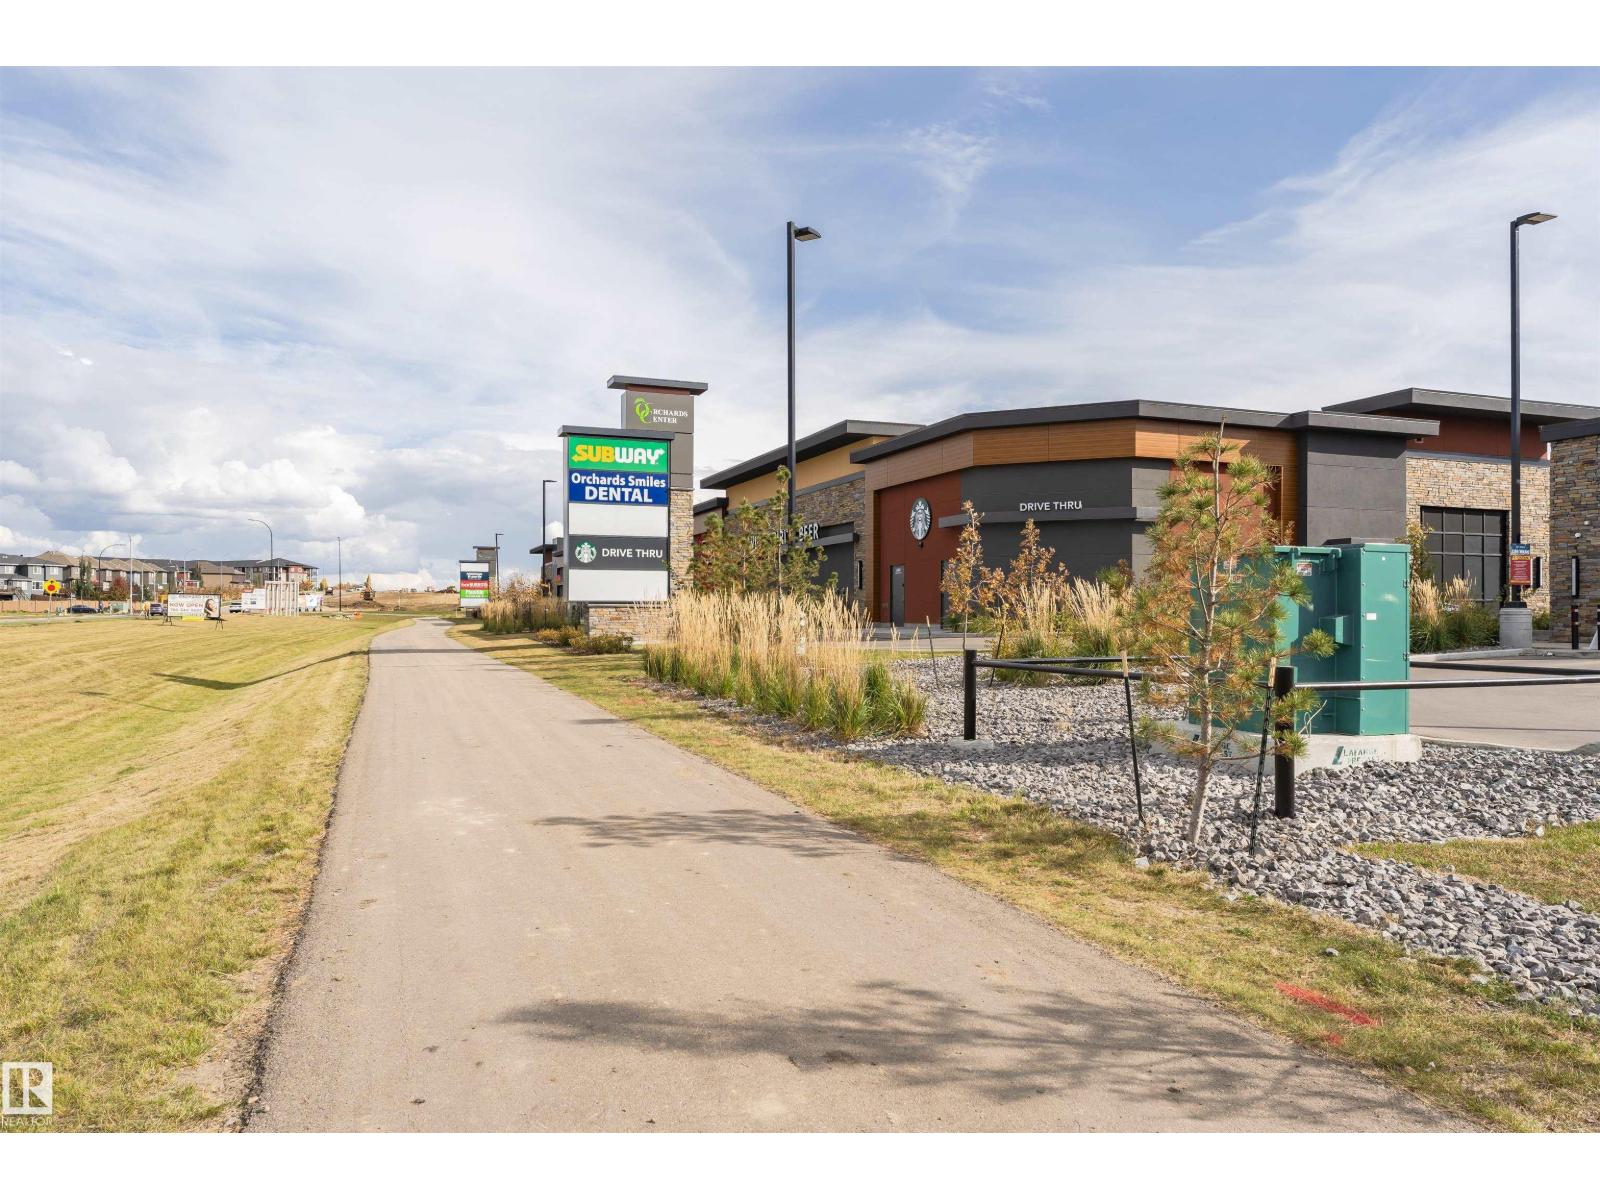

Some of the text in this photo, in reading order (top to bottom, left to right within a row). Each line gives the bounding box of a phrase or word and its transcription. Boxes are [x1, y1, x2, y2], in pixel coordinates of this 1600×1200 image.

[572, 444, 665, 465] SUBWAY
[571, 472, 666, 488] Orchards Smiles
[585, 486, 653, 502] DENTAL
[1019, 500, 1082, 511] DRIVE THRU
[602, 548, 663, 558] DRIVE THRU
